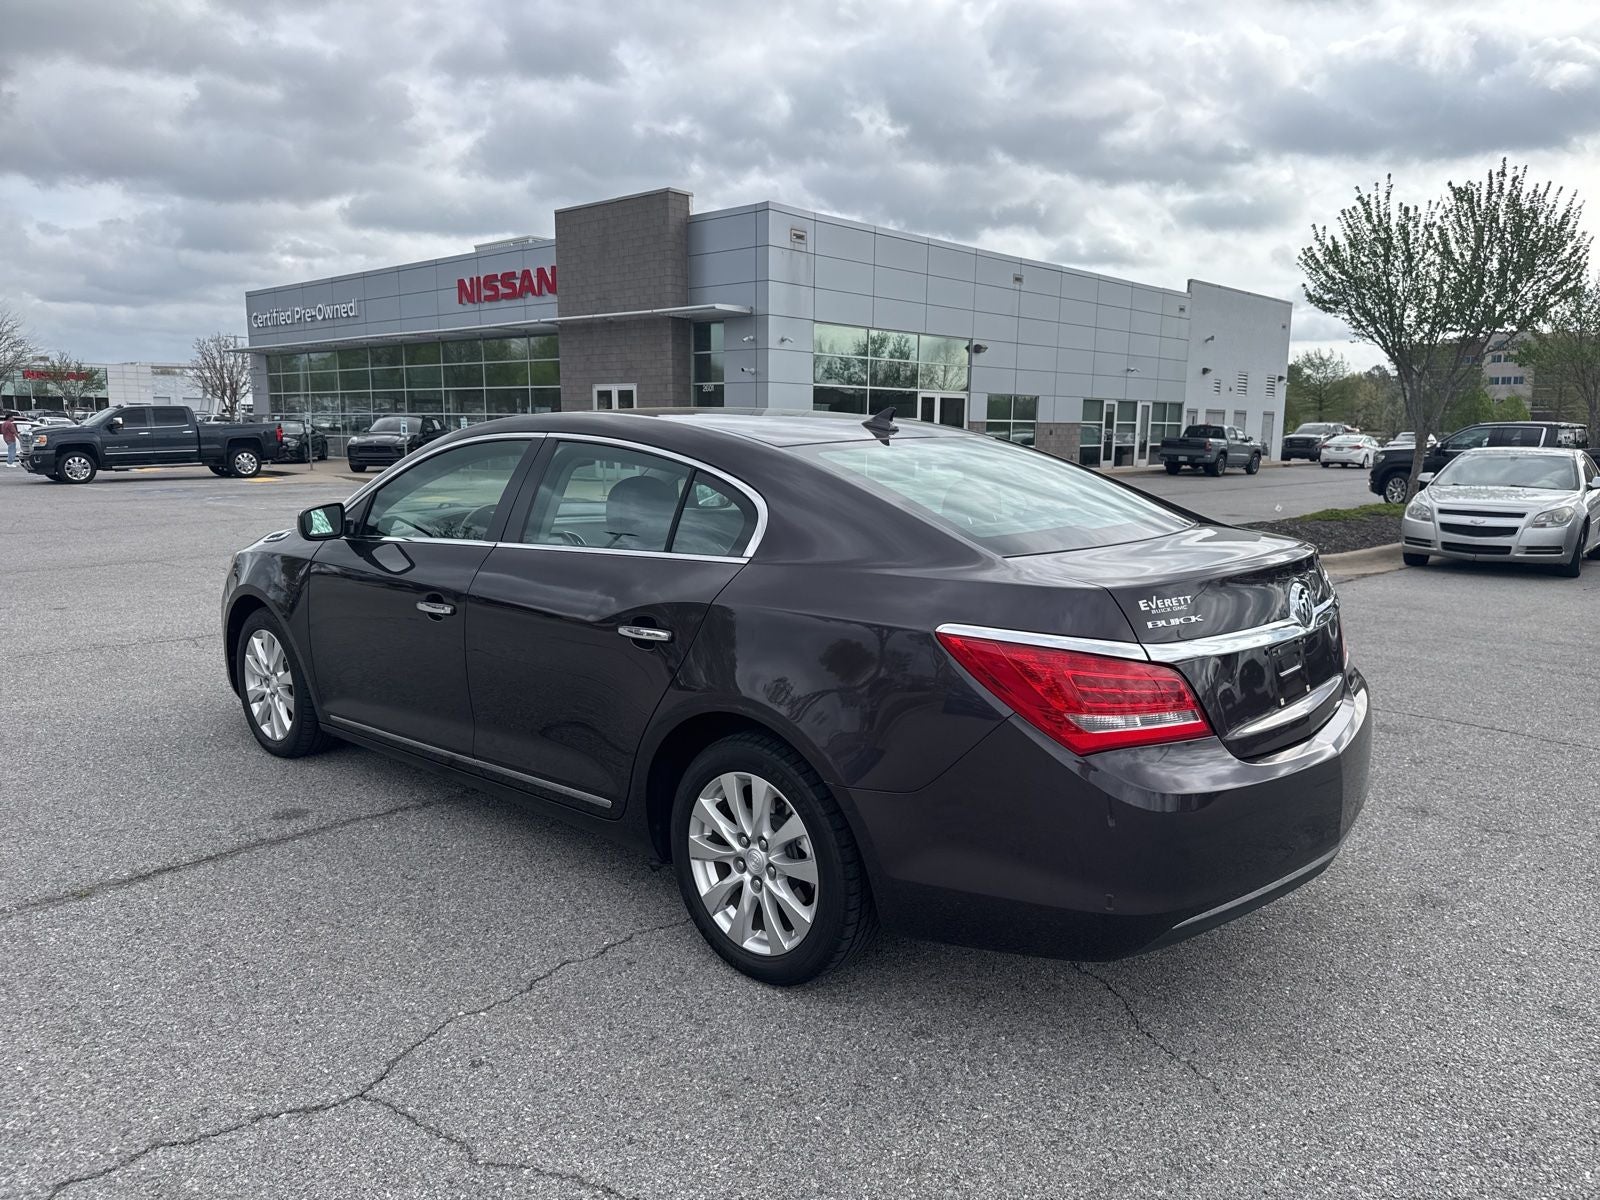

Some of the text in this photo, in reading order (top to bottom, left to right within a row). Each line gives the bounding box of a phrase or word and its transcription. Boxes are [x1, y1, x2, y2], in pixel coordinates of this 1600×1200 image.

[457, 265, 557, 304] NISSAN
[251, 298, 358, 328] Certified Pre-Owned
[1138, 595, 1191, 610] EVERETT
[1147, 614, 1204, 628] BUICK
